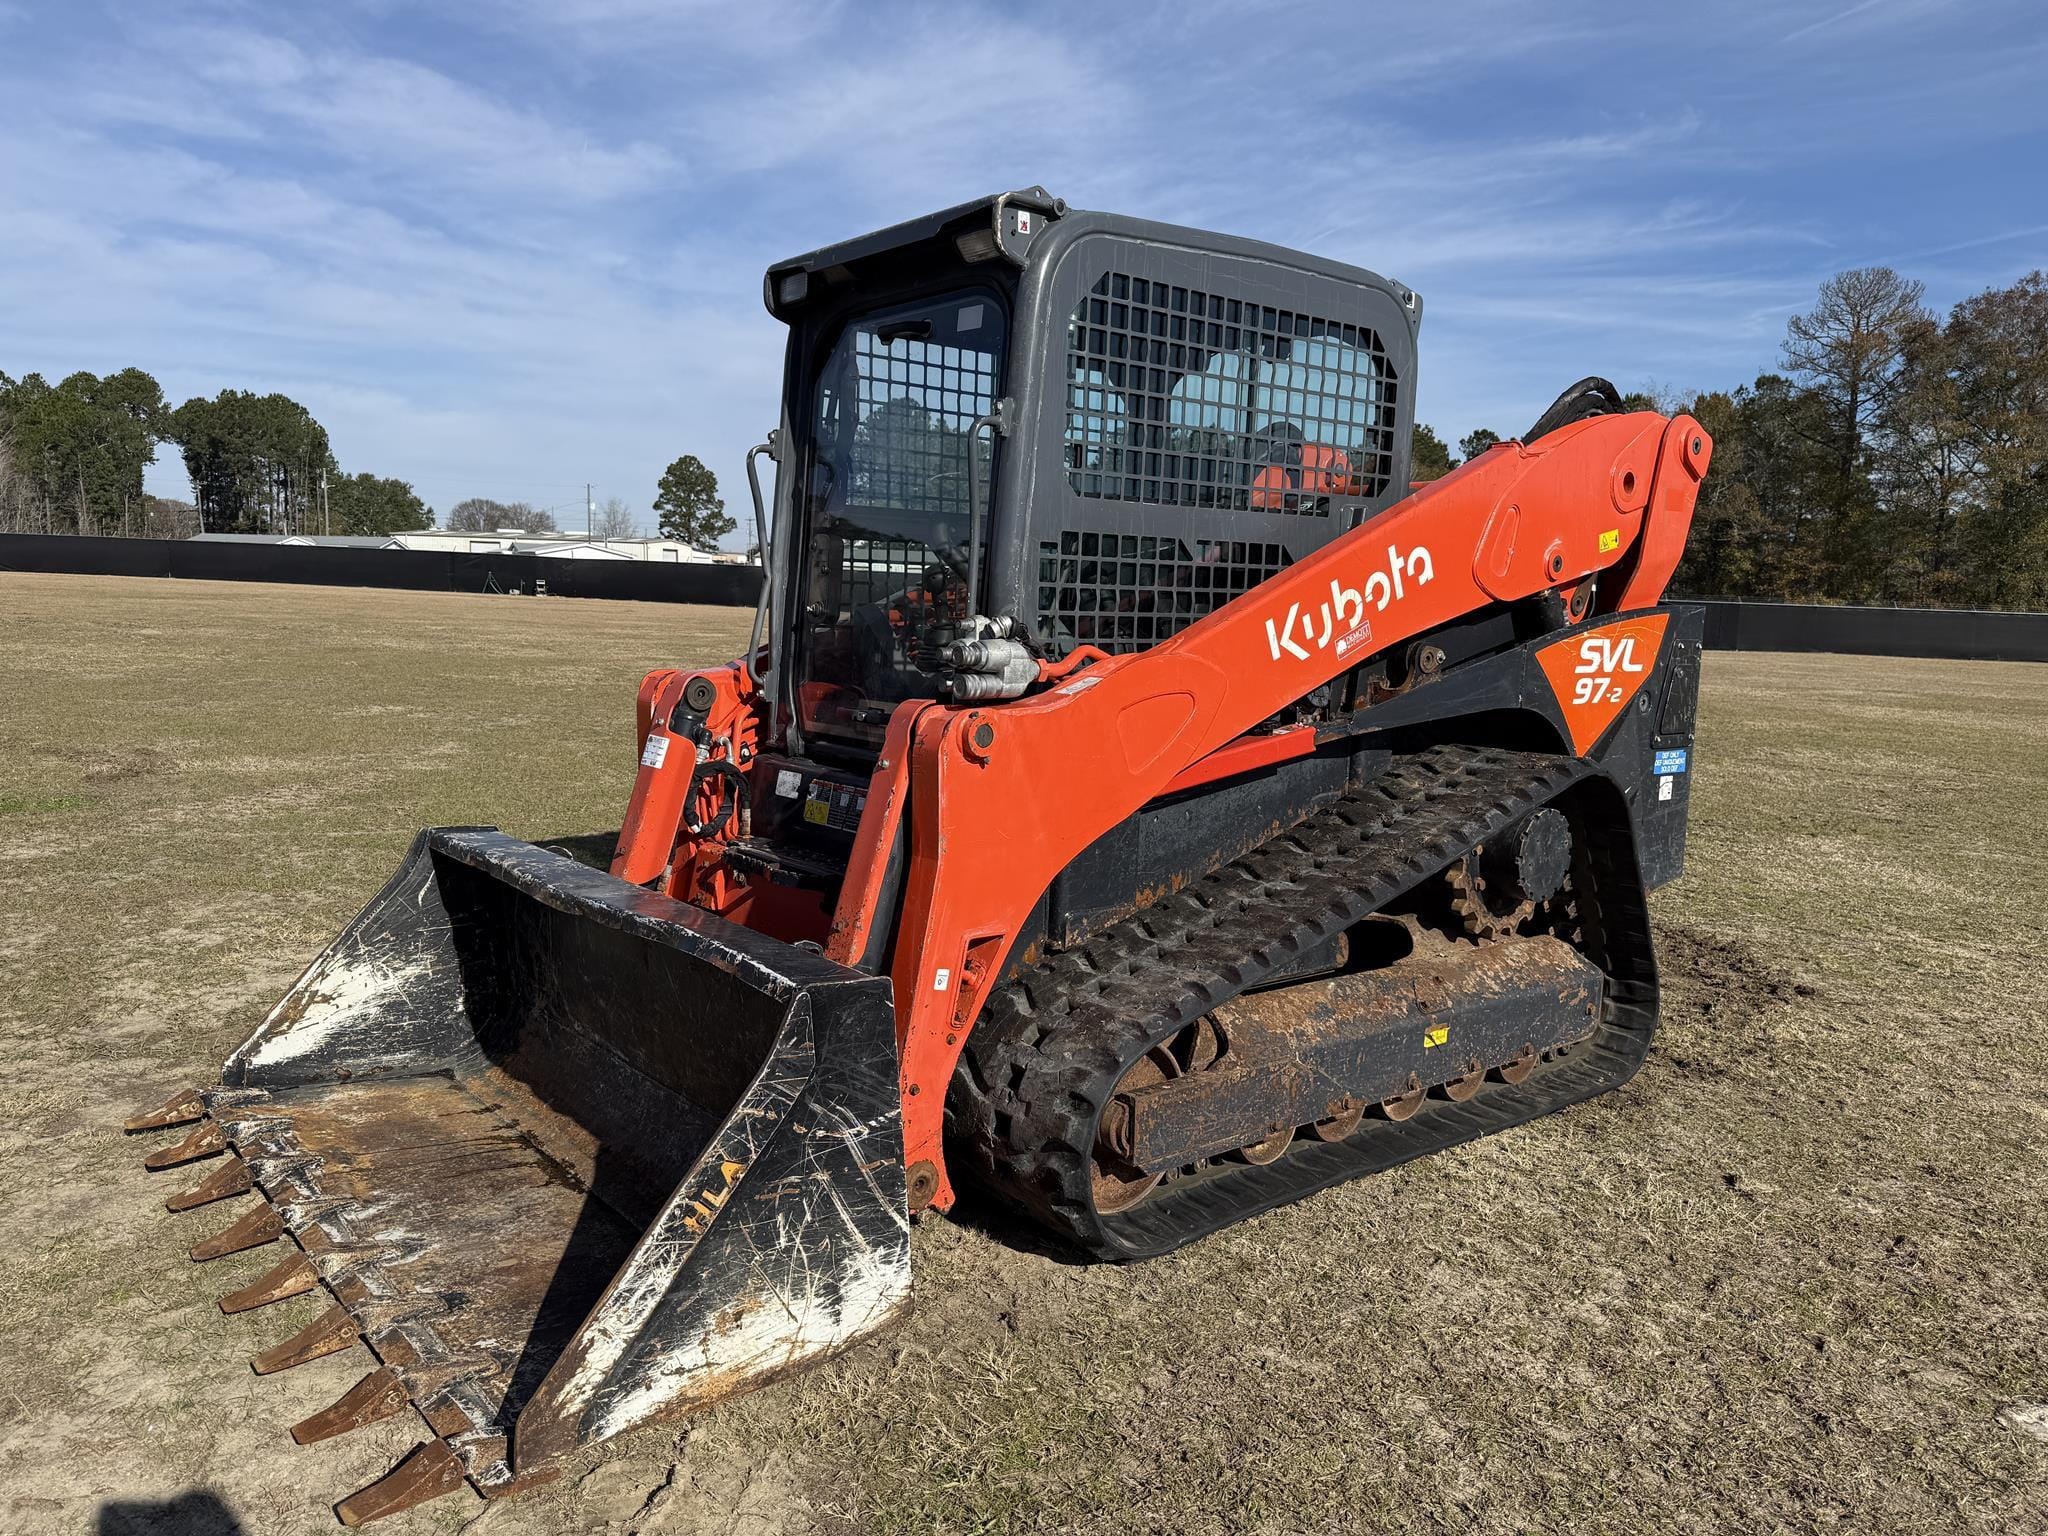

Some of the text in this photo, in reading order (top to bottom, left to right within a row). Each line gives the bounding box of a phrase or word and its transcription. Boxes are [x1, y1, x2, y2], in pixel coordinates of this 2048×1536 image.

[1265, 544, 1434, 661] Kubota
[1574, 638, 1645, 674] SVL
[1572, 677, 1623, 705] 97-2
